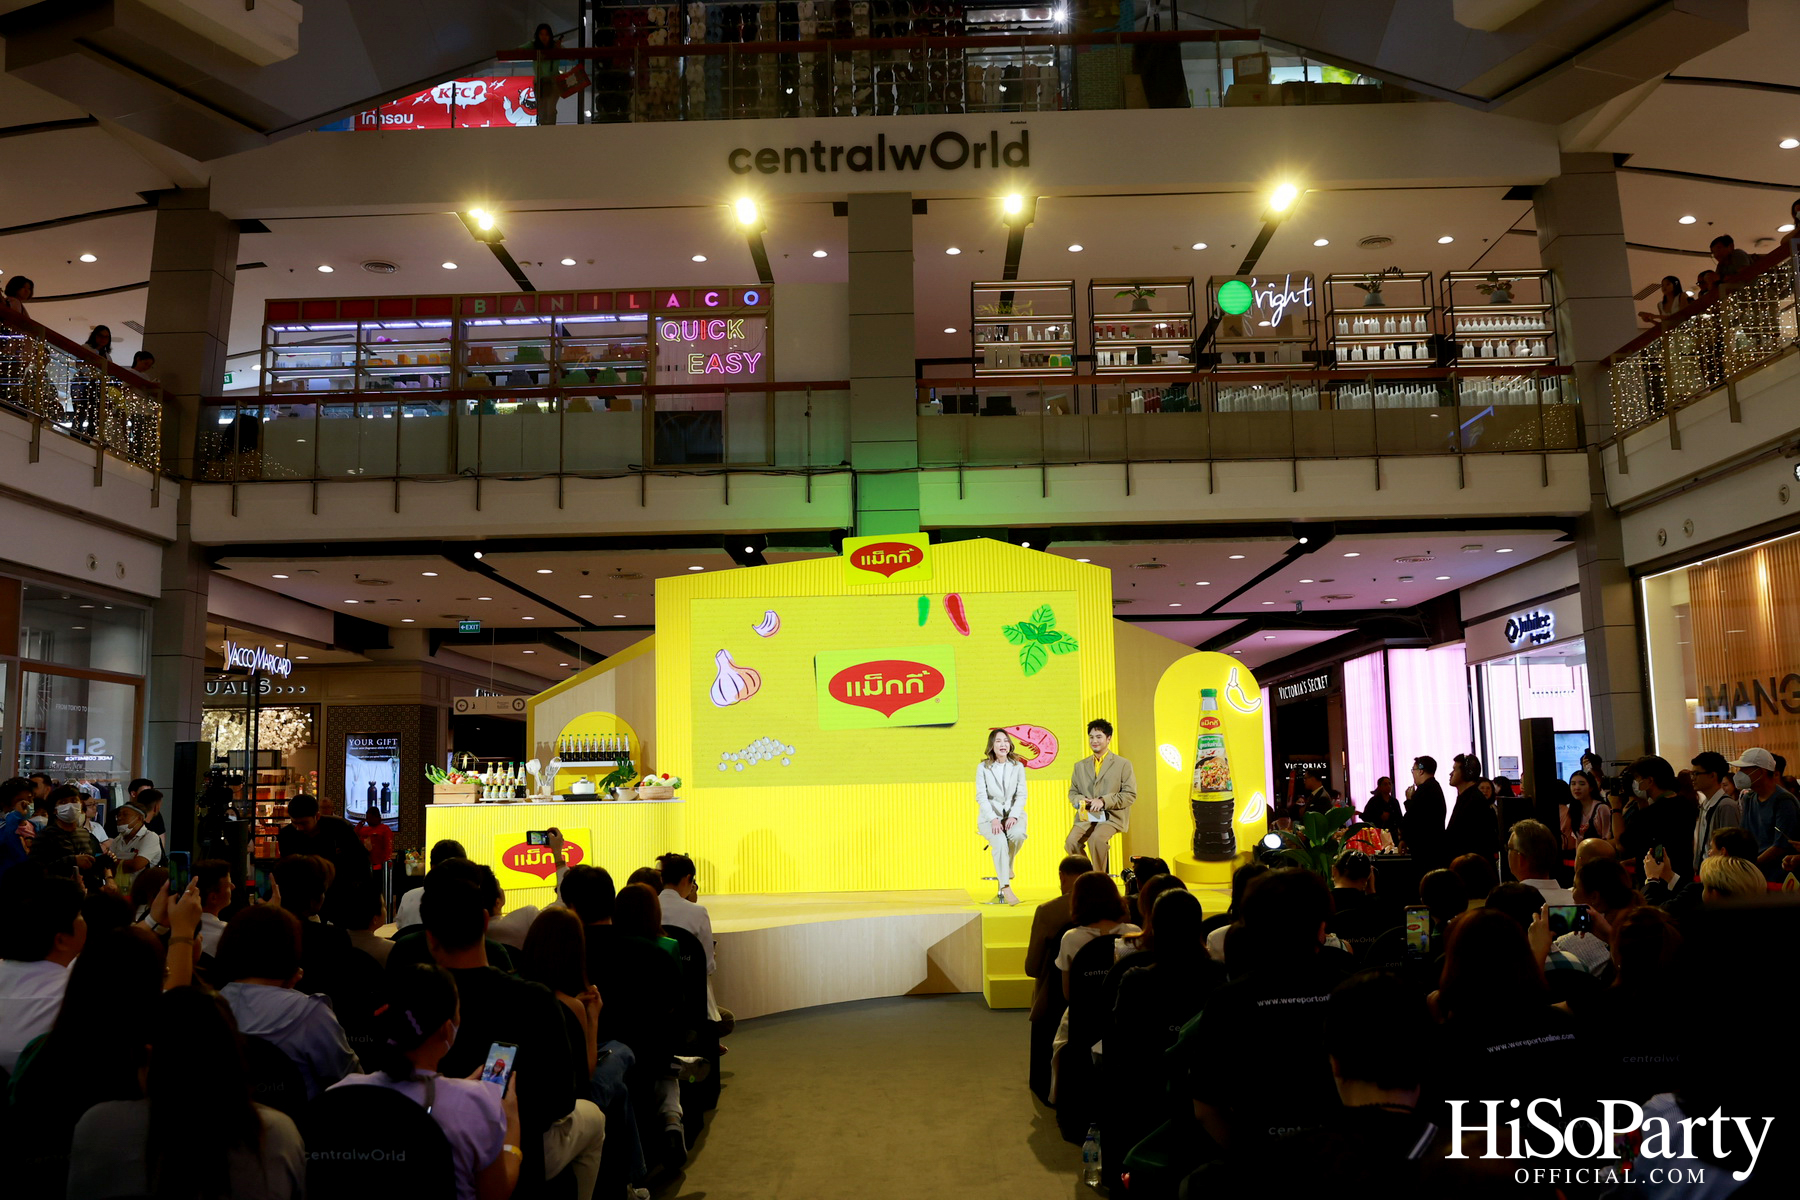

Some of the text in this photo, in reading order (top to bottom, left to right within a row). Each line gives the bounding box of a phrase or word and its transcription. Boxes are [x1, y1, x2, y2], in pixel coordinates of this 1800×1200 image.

[438, 87, 473, 99] KFC
[360, 111, 414, 125] ไก่กรอบ
[728, 129, 1030, 174] centralwOrld
[660, 319, 745, 342] QUICK
[688, 352, 762, 375] EASY
[861, 548, 915, 566] แม็กกี้
[1518, 611, 1551, 638] Jubilee
[846, 670, 931, 697] แม็กกี้
[1278, 674, 1329, 700] VICTORIA'S SECRET
[349, 738, 398, 746] YOUR GIFT
[1487, 1033, 1575, 1053] www.wereportonline.com
